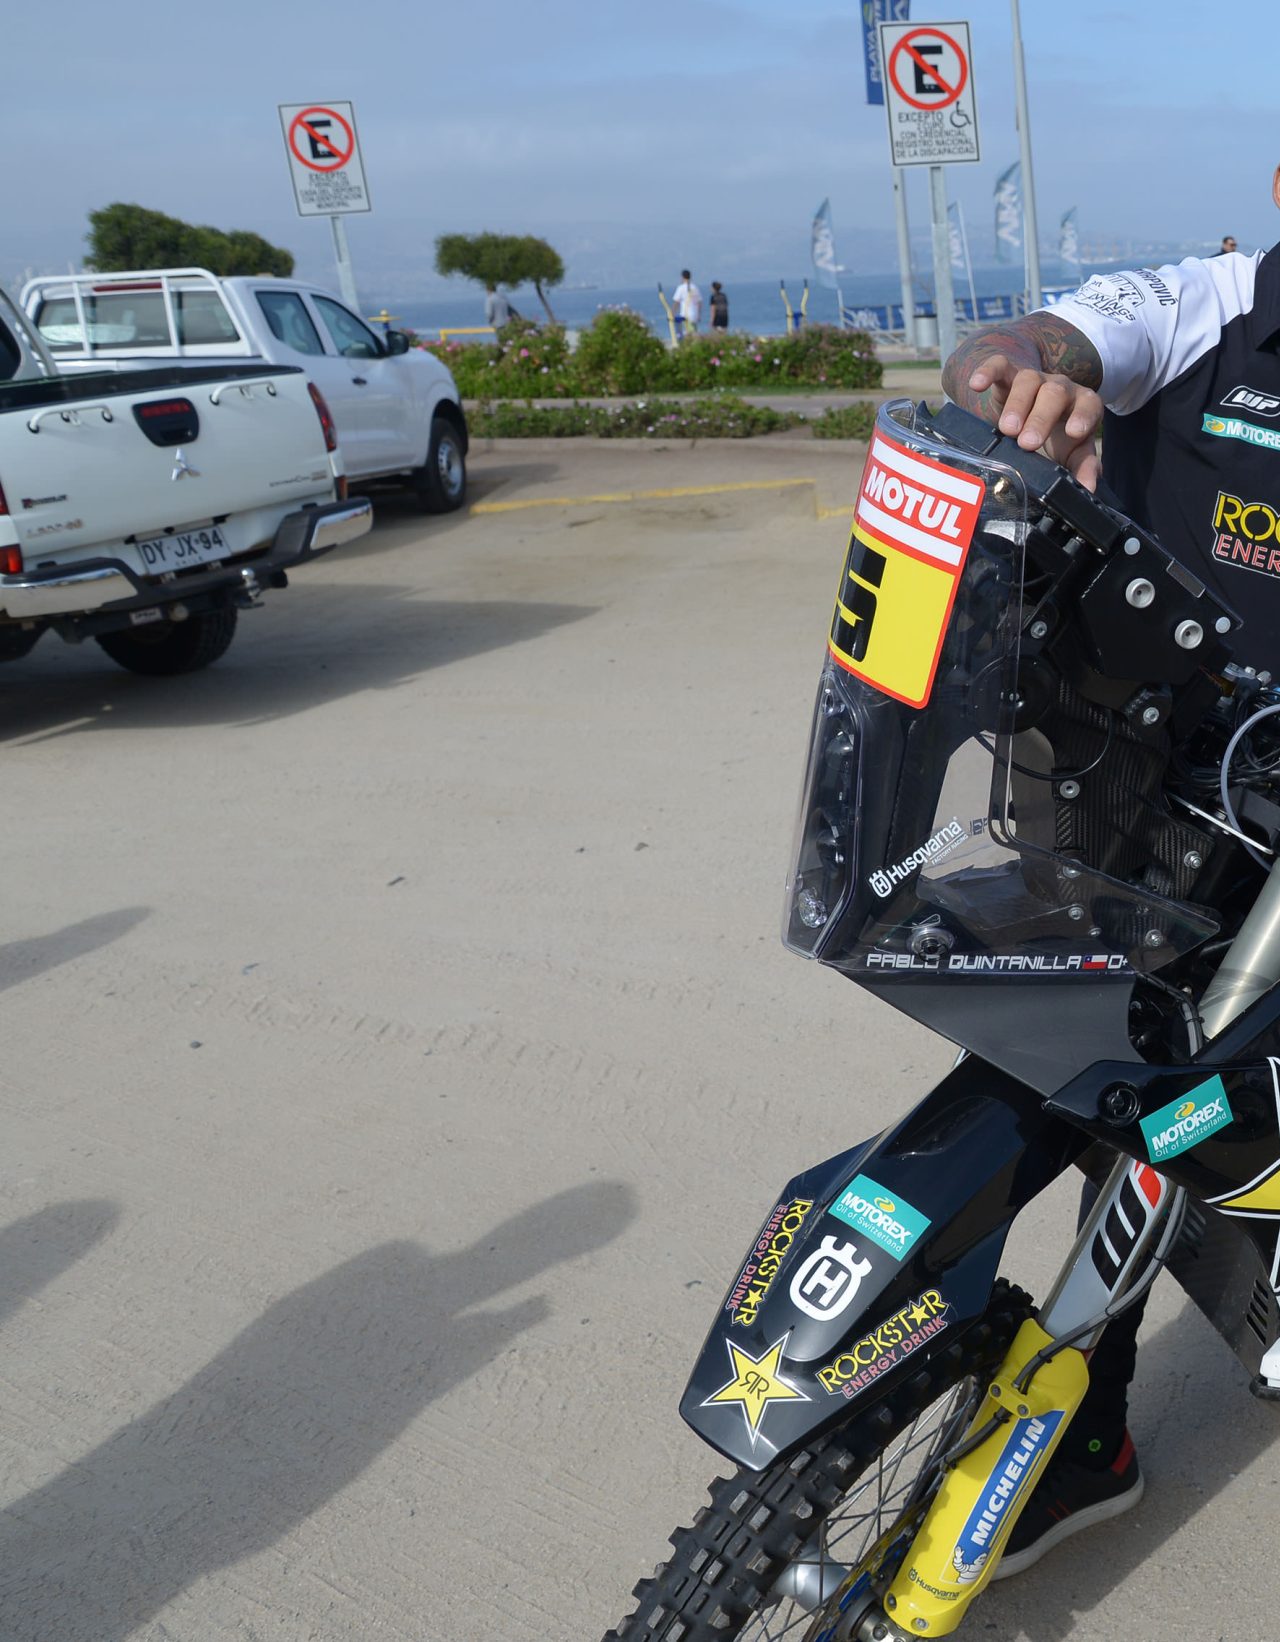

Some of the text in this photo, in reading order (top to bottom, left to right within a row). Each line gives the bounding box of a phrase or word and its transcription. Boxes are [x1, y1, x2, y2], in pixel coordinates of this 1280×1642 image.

[898, 111, 944, 123] EXCEPTO
[919, 128, 967, 139] CREDENCIAL
[895, 138, 973, 149] REGISTRO NACIONAL
[895, 146, 976, 159] DE LA DISCAPACIDAD
[308, 171, 348, 182] EXCEPTO
[1232, 390, 1280, 411] WP
[864, 465, 962, 539] MOTUL
[886, 820, 962, 886] Husqvarna
[930, 833, 970, 866] FACTORY RACING
[866, 953, 939, 969] PABLO
[948, 954, 1082, 970] QUINTANILLA
[1151, 1097, 1224, 1152] MOTOREX
[1155, 1111, 1228, 1157] Oil of Switzerland
[835, 1203, 904, 1253] Oil of Switzerland
[840, 1191, 912, 1246] MOTOREX
[727, 1204, 789, 1311] ENERGY DRINK
[840, 1315, 946, 1398] ENERGY DRINK
[969, 1417, 1047, 1547] MICHELIN
[916, 1576, 961, 1598] Husqvarna
